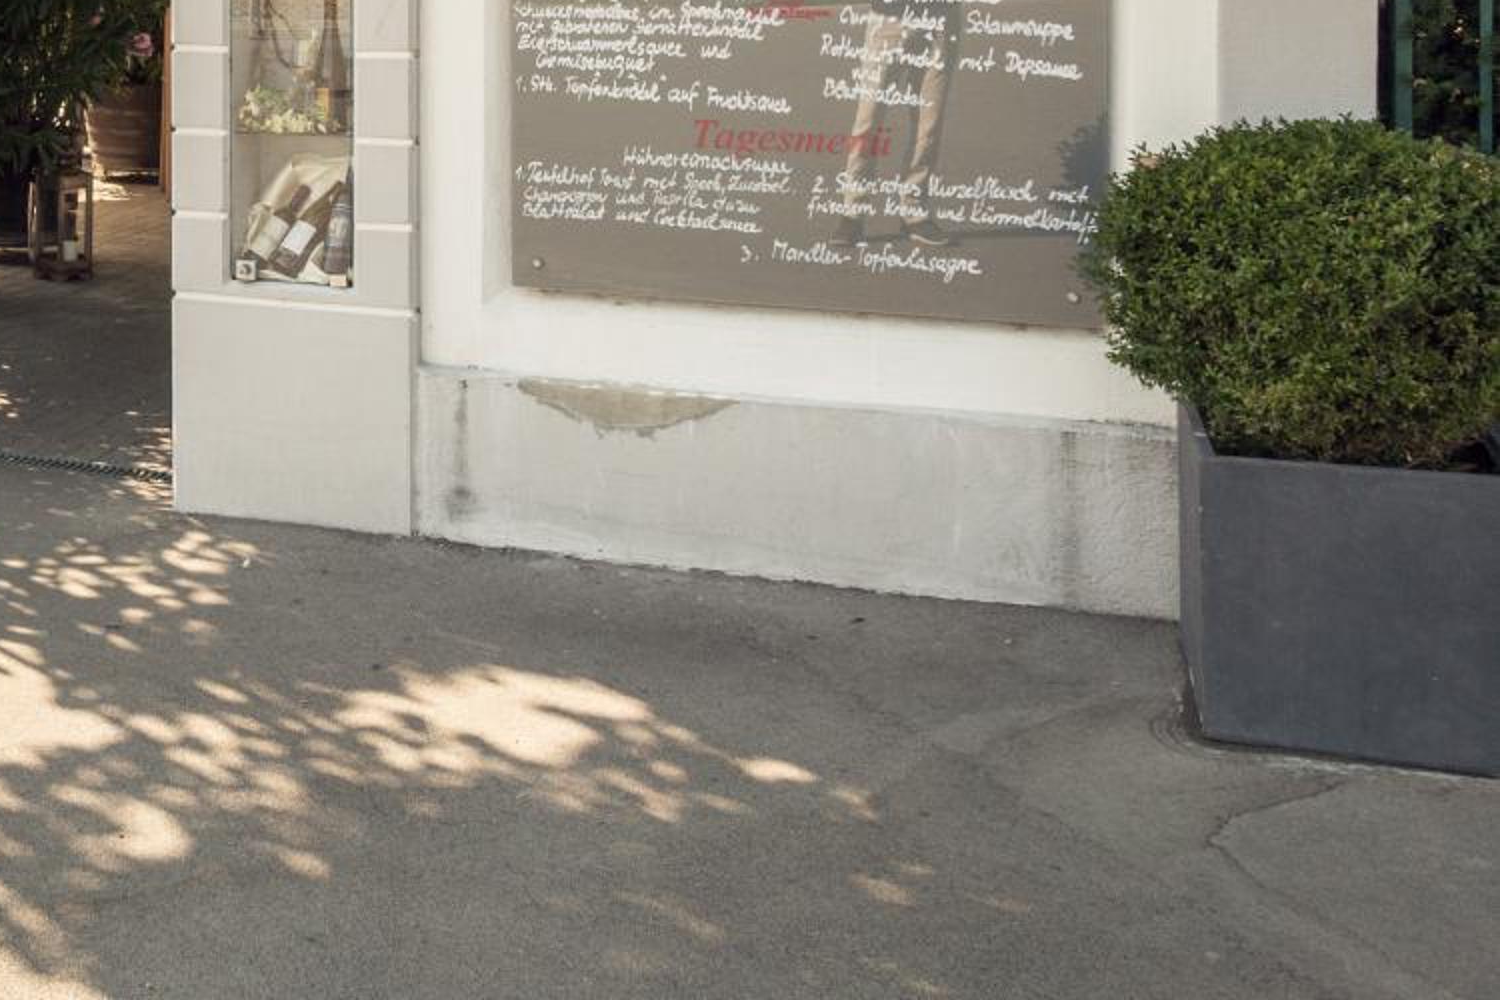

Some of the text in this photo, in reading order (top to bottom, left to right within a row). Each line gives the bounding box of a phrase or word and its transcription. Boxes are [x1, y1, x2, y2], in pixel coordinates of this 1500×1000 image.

[700, 40, 732, 59] und
[958, 47, 996, 72] mit
[667, 80, 700, 112] auf
[693, 119, 893, 157] Tagesmenü
[1049, 184, 1090, 204] mit
[936, 205, 966, 223] und
